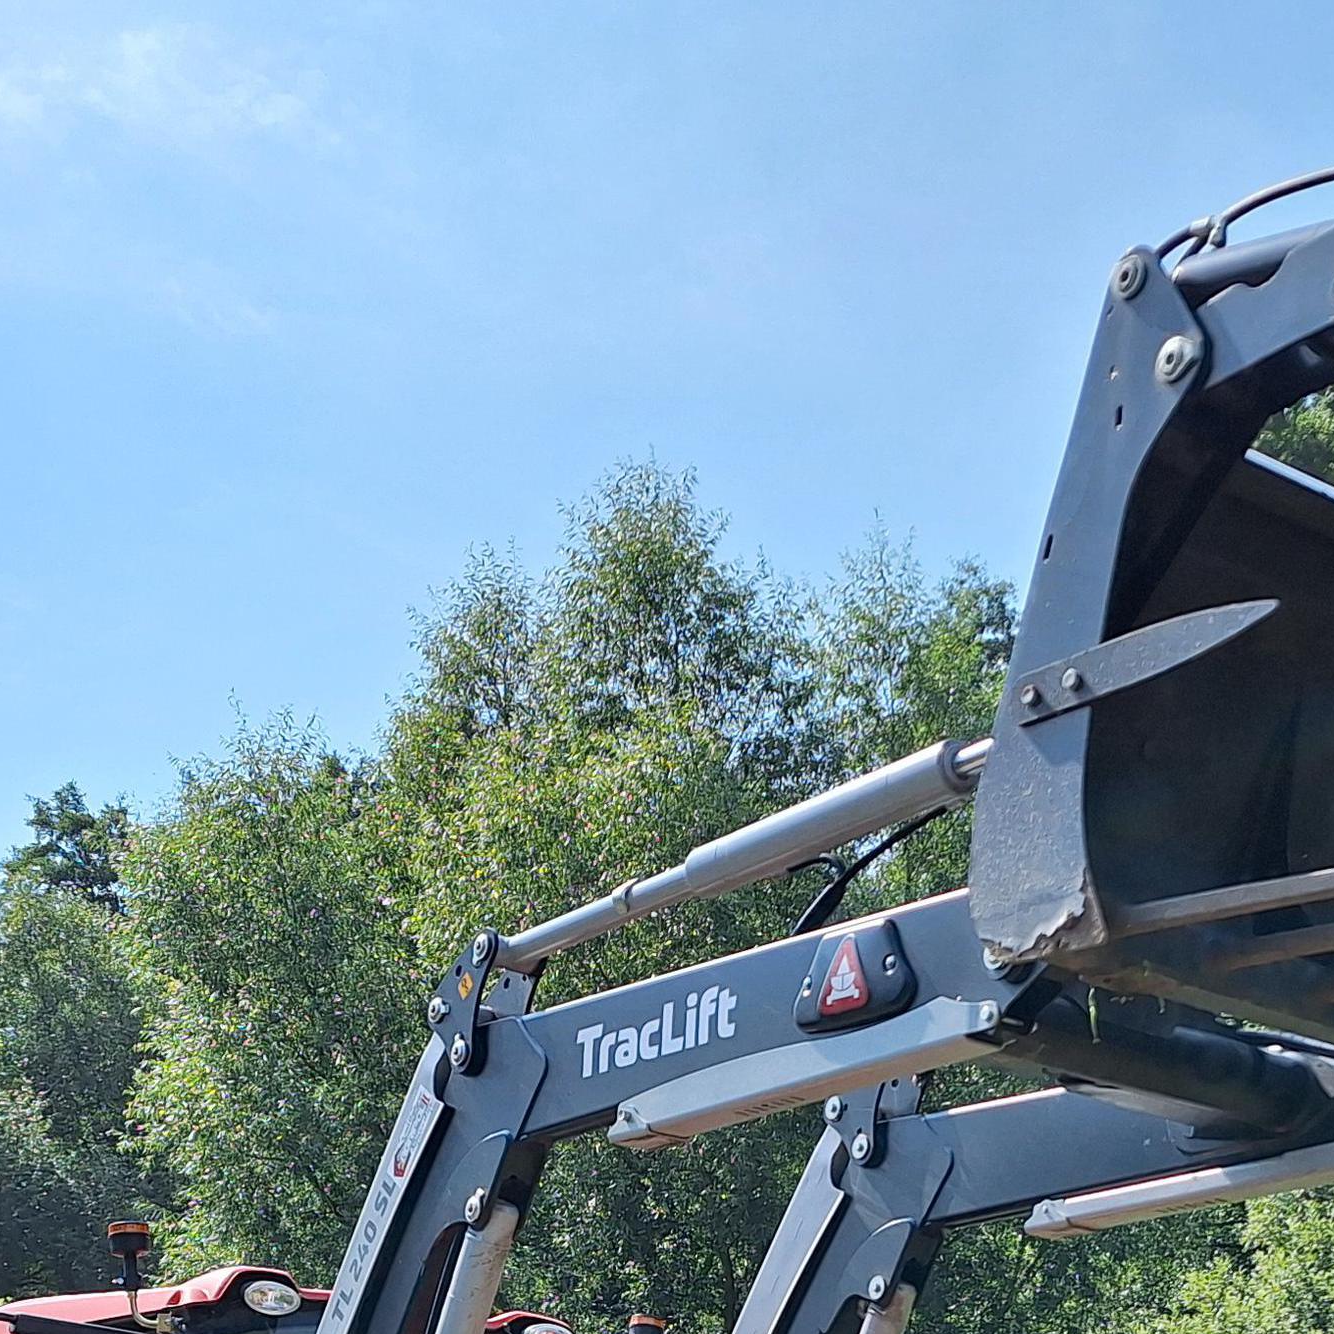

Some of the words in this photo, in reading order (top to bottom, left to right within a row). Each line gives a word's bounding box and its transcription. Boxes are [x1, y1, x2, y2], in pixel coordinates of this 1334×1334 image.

[576, 985, 738, 1079] TracLift
[331, 1288, 354, 1322] TL
[349, 1220, 377, 1282] 240
[374, 1175, 397, 1217] SL
